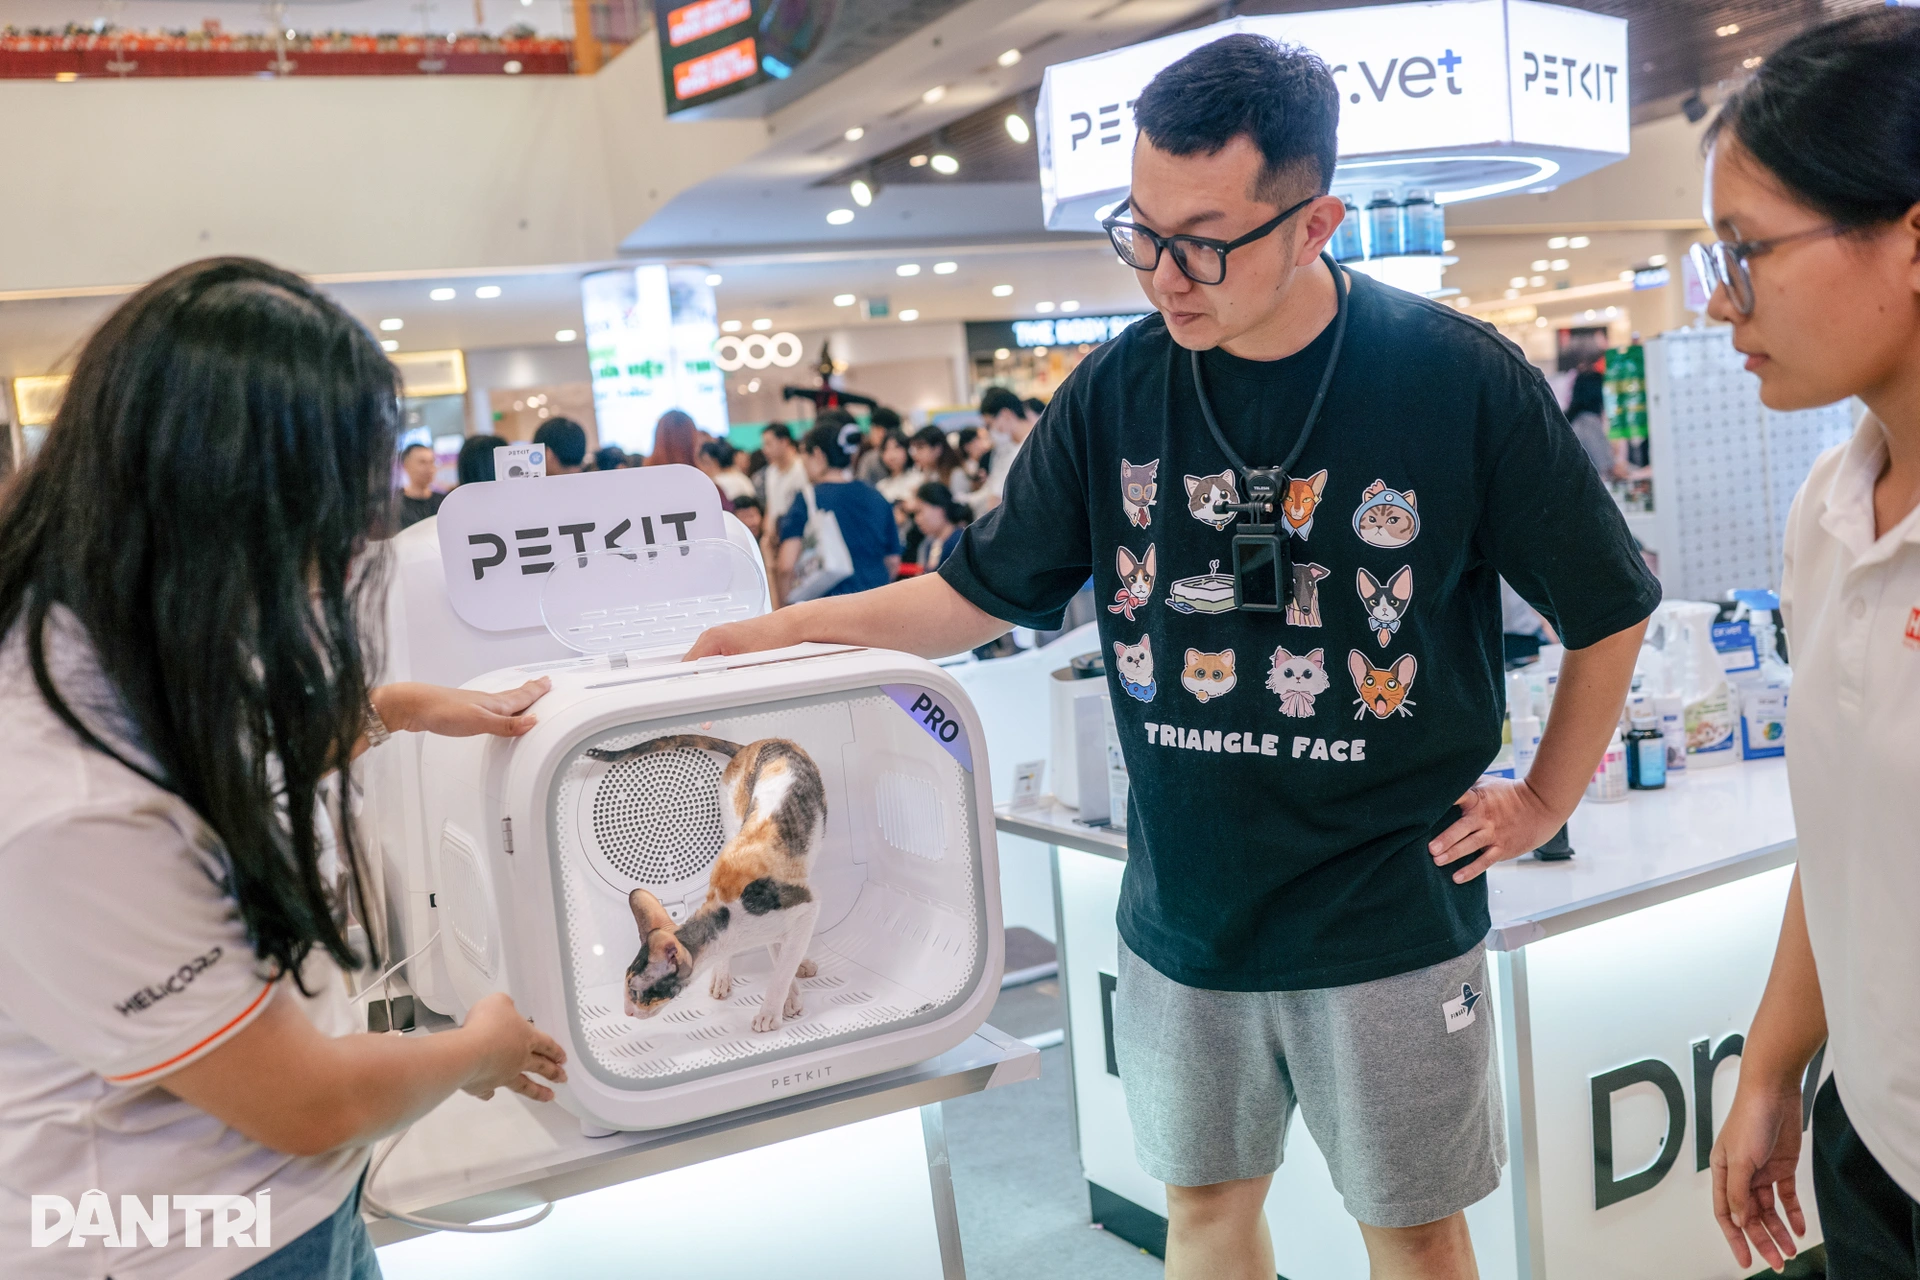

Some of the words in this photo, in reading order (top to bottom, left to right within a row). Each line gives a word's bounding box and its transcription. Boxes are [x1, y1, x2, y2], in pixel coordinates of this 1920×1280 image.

[1327, 49, 1463, 104] r.vet
[1523, 51, 1618, 103] PETKIT
[1070, 99, 1137, 152] PE
[468, 511, 697, 581] PETKIT
[910, 692, 959, 743] PRO
[1144, 722, 1279, 757] TRIANGLE
[1291, 736, 1366, 762] FACE
[771, 1066, 832, 1089] PETKIT
